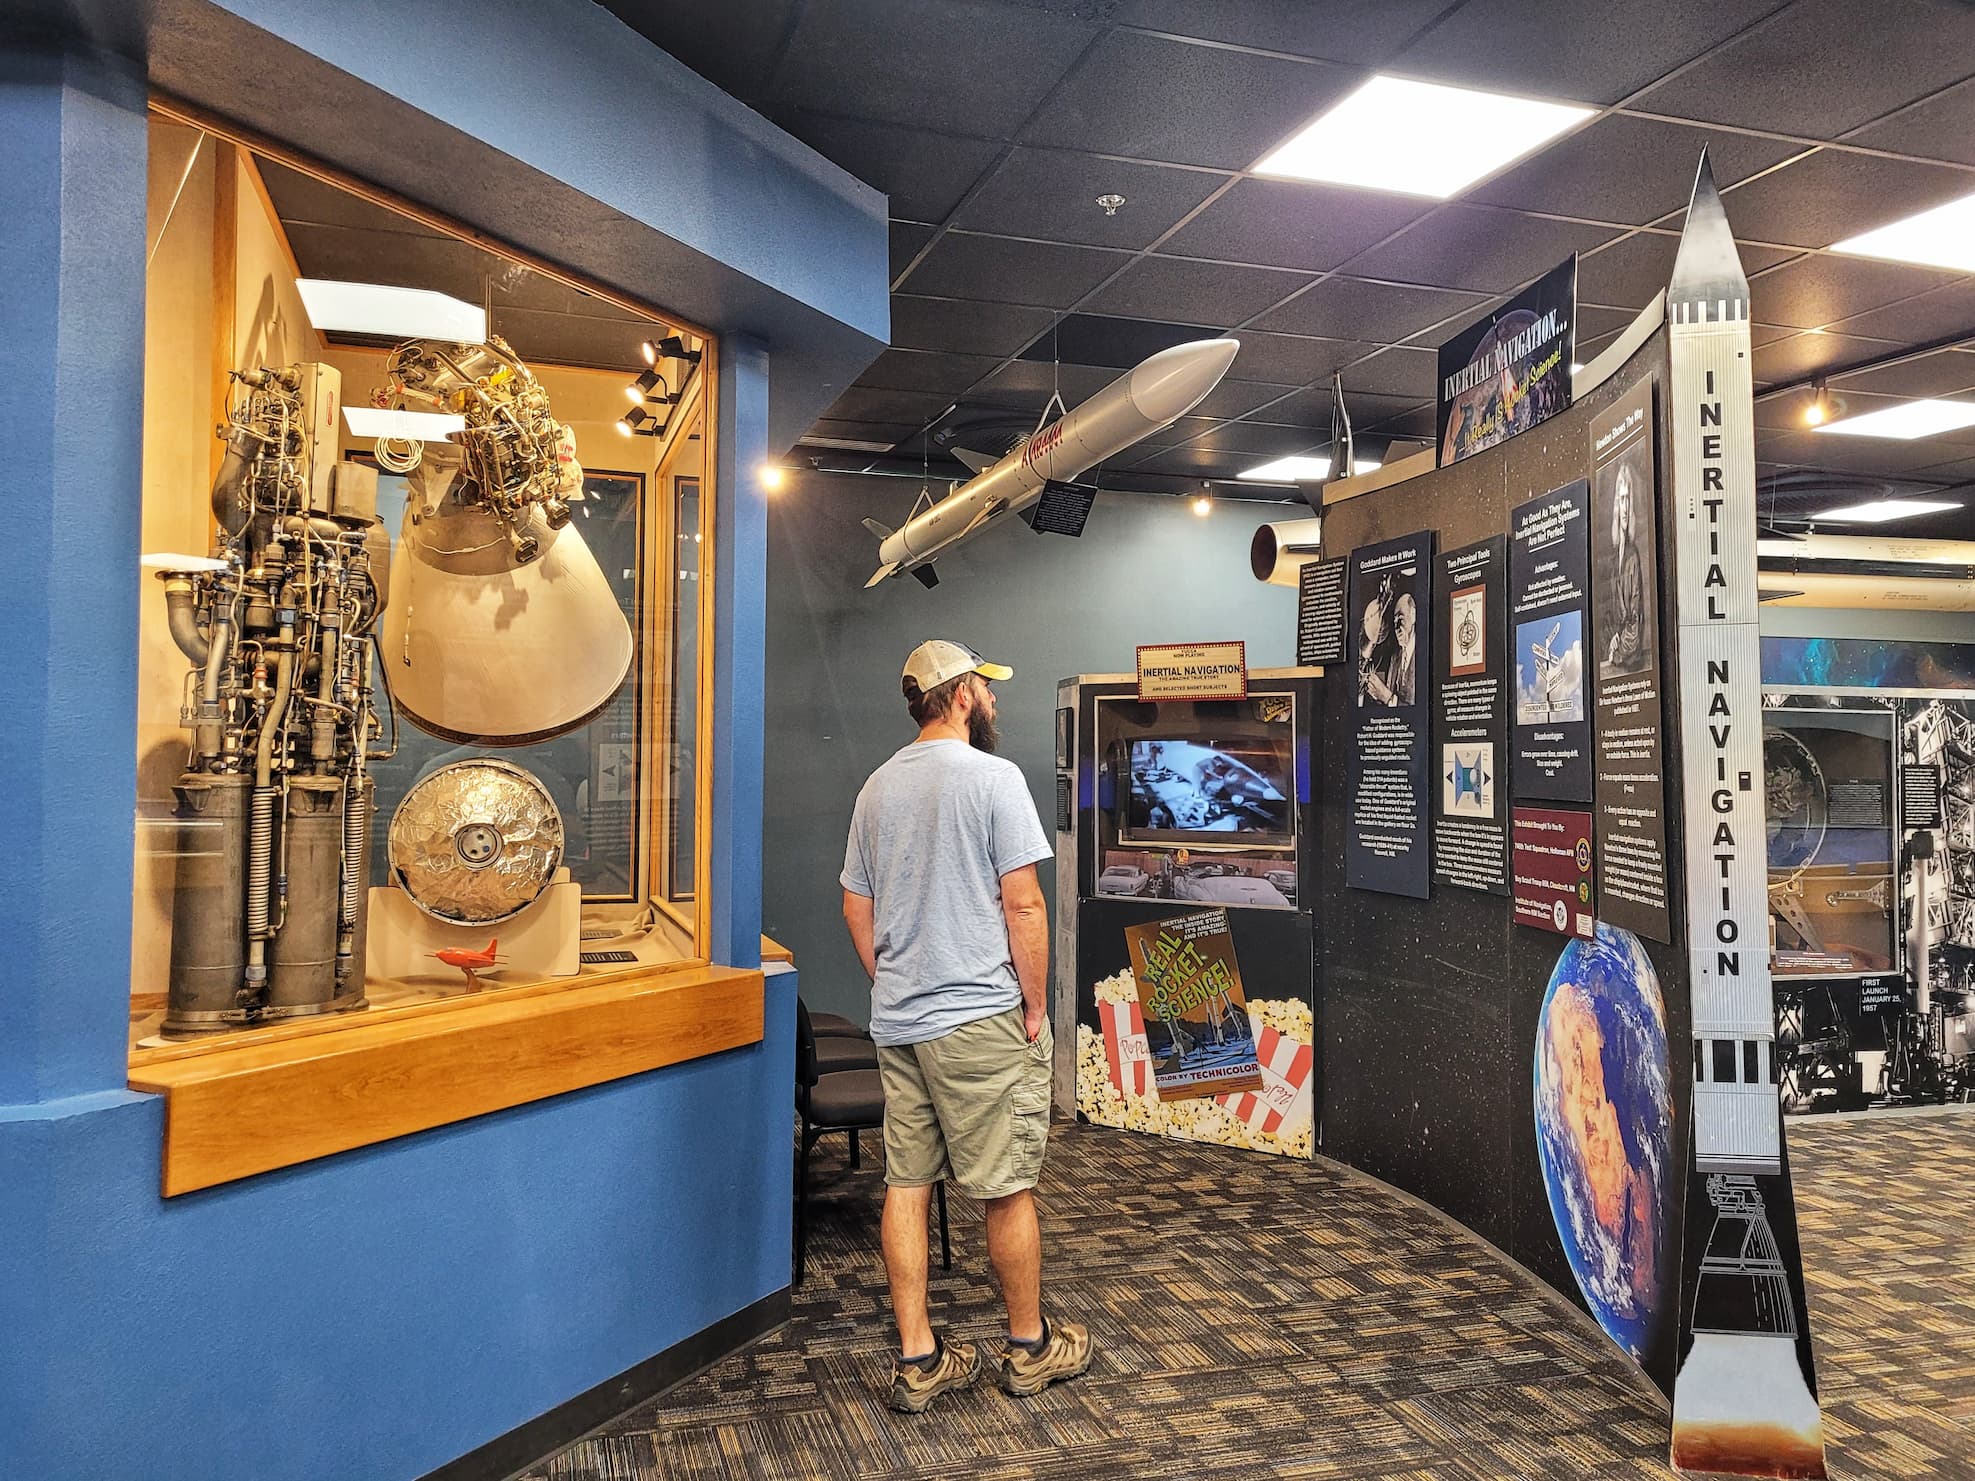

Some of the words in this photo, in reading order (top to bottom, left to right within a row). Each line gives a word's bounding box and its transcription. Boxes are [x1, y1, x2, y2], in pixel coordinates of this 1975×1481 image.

[1444, 353, 1492, 402] INERTIAL
[1494, 308, 1568, 375] NAVIGATION...
[1472, 412, 1495, 440] Really
[1529, 340, 1562, 387] Science!
[1612, 422, 1626, 440] Shows
[1626, 415, 1634, 428] The
[1700, 371, 1727, 620] INERTIAL
[1522, 517, 1528, 527] As
[1529, 510, 1541, 523] Good
[1542, 508, 1548, 518] As
[1548, 504, 1561, 515] They
[1561, 500, 1572, 511] Are,
[1515, 525, 1532, 540] Inertial
[1532, 517, 1558, 533] Navigation
[1558, 508, 1580, 525] Systems
[1528, 537, 1537, 547] Are
[1537, 531, 1546, 543] Not
[1547, 524, 1565, 540] Perfect
[1360, 557, 1381, 569] Goddard
[1382, 555, 1397, 564] Makes
[1398, 552, 1402, 560] It
[1403, 549, 1416, 559] Work
[1447, 560, 1456, 568] Two
[1457, 552, 1477, 566] Principal
[1478, 549, 1490, 560] Tools
[1454, 570, 1481, 584] Gyroscopes
[1143, 667, 1182, 677] INERTIAL
[1184, 665, 1240, 675] NAVIGATION
[1451, 728, 1487, 737] Accelerometers
[1707, 660, 1740, 976] NAVIGATION
[1522, 876, 1531, 884] Scout
[1160, 917, 1187, 928] INERTIAL
[1187, 909, 1224, 921] NAVIGATION
[1171, 923, 1184, 931] THE
[1184, 920, 1205, 929] INSIDE
[1209, 926, 1228, 935] TRUE!
[1144, 930, 1182, 982] REAL
[1146, 941, 1204, 1013] ROCKET
[1159, 958, 1236, 1023] SCIENCE!
[1862, 987, 1888, 995] LAUNCH
[1862, 995, 1891, 1003] JANUARY
[1862, 1004, 1877, 1012] 1957
[1155, 1074, 1177, 1082] COLOR
[1179, 1073, 1189, 1081] BY
[1190, 1063, 1259, 1081] TECHNICOLOR
